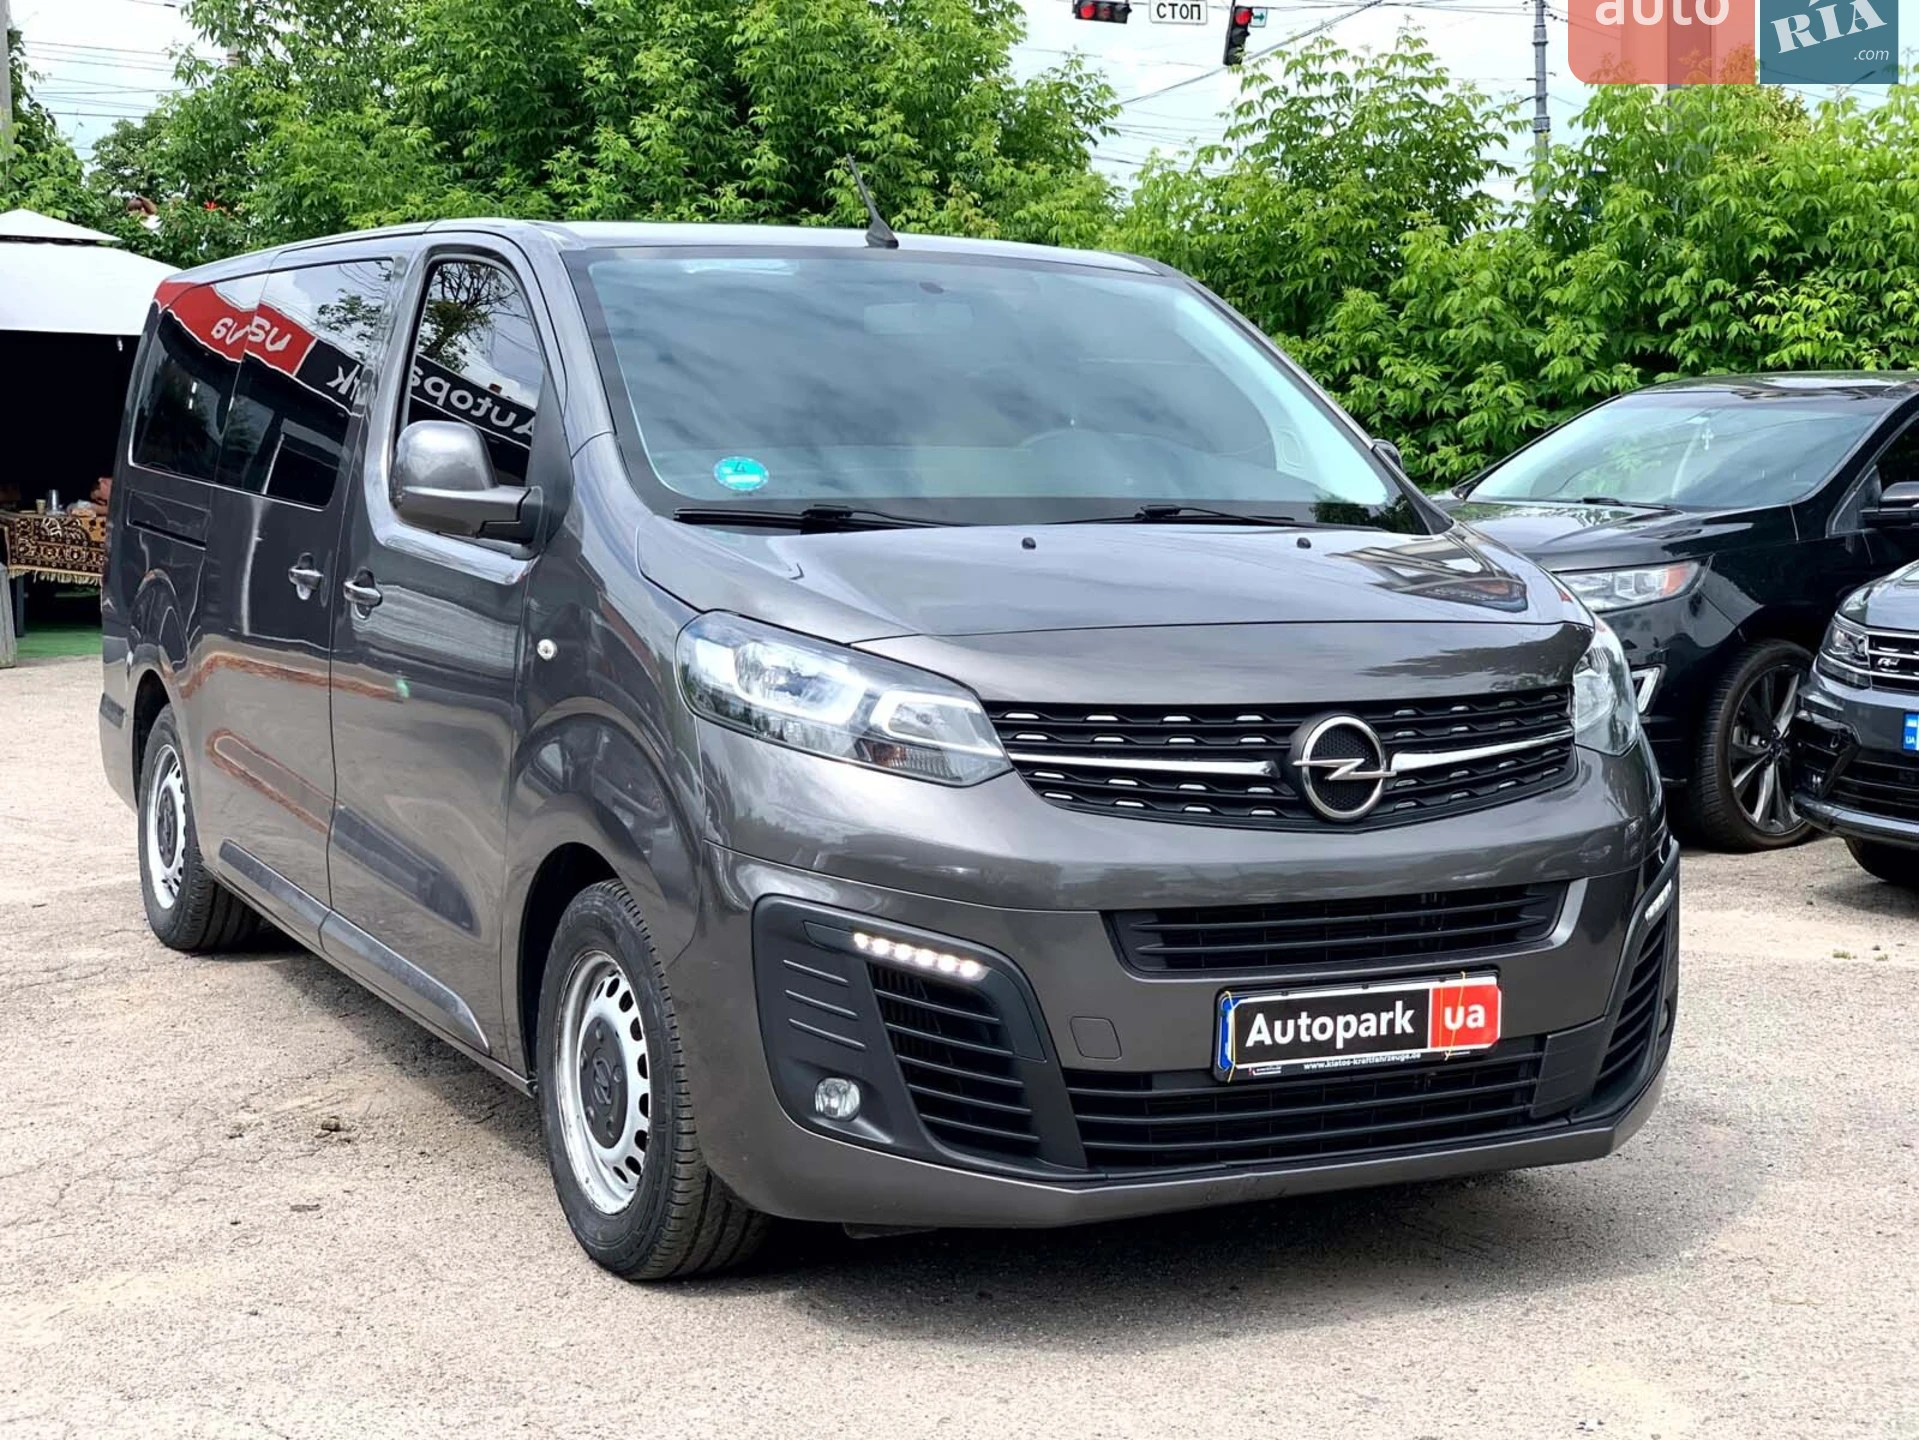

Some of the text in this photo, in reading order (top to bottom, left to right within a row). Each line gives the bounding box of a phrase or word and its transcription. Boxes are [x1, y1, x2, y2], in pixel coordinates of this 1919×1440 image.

[1156, 2, 1201, 21] СТОП
[1245, 1000, 1486, 1050] Autopark ua
